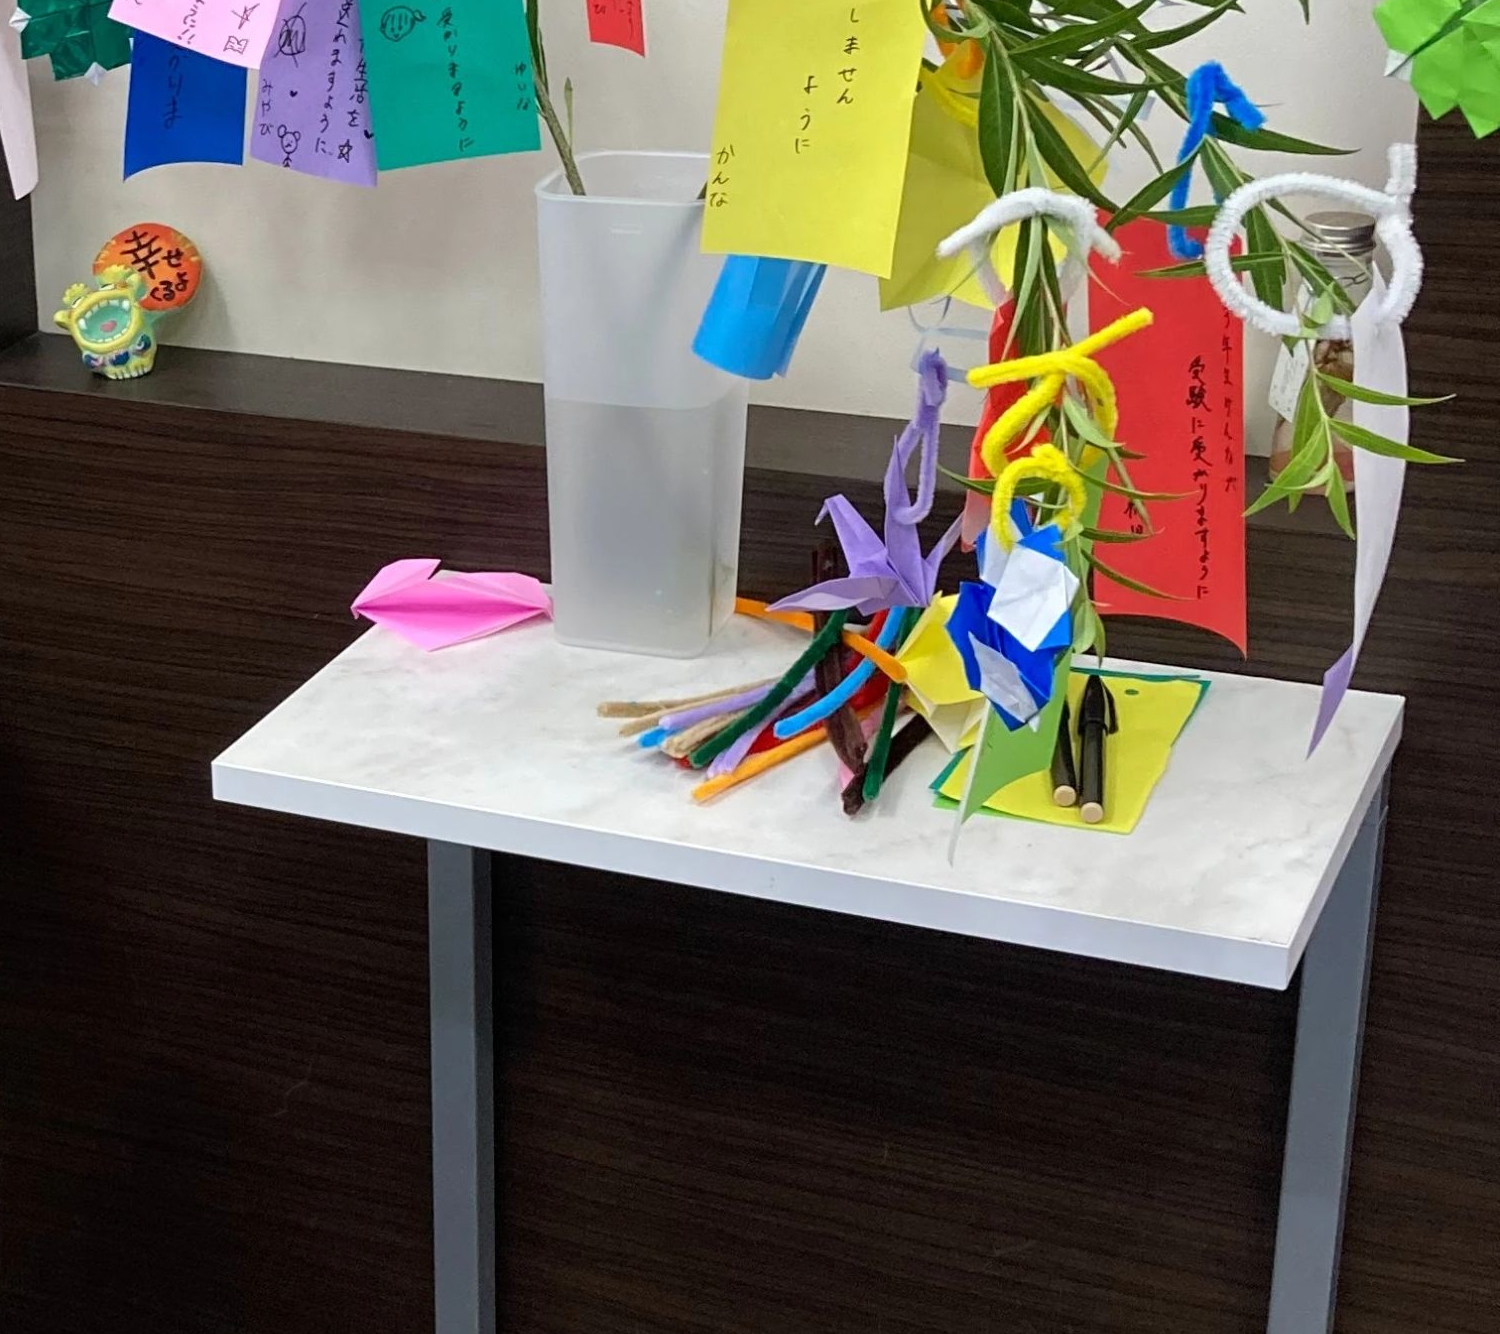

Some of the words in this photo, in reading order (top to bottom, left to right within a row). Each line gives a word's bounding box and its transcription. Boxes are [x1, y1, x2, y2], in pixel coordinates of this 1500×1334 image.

[795, 74, 819, 154] ように
[708, 143, 735, 208] かんな
